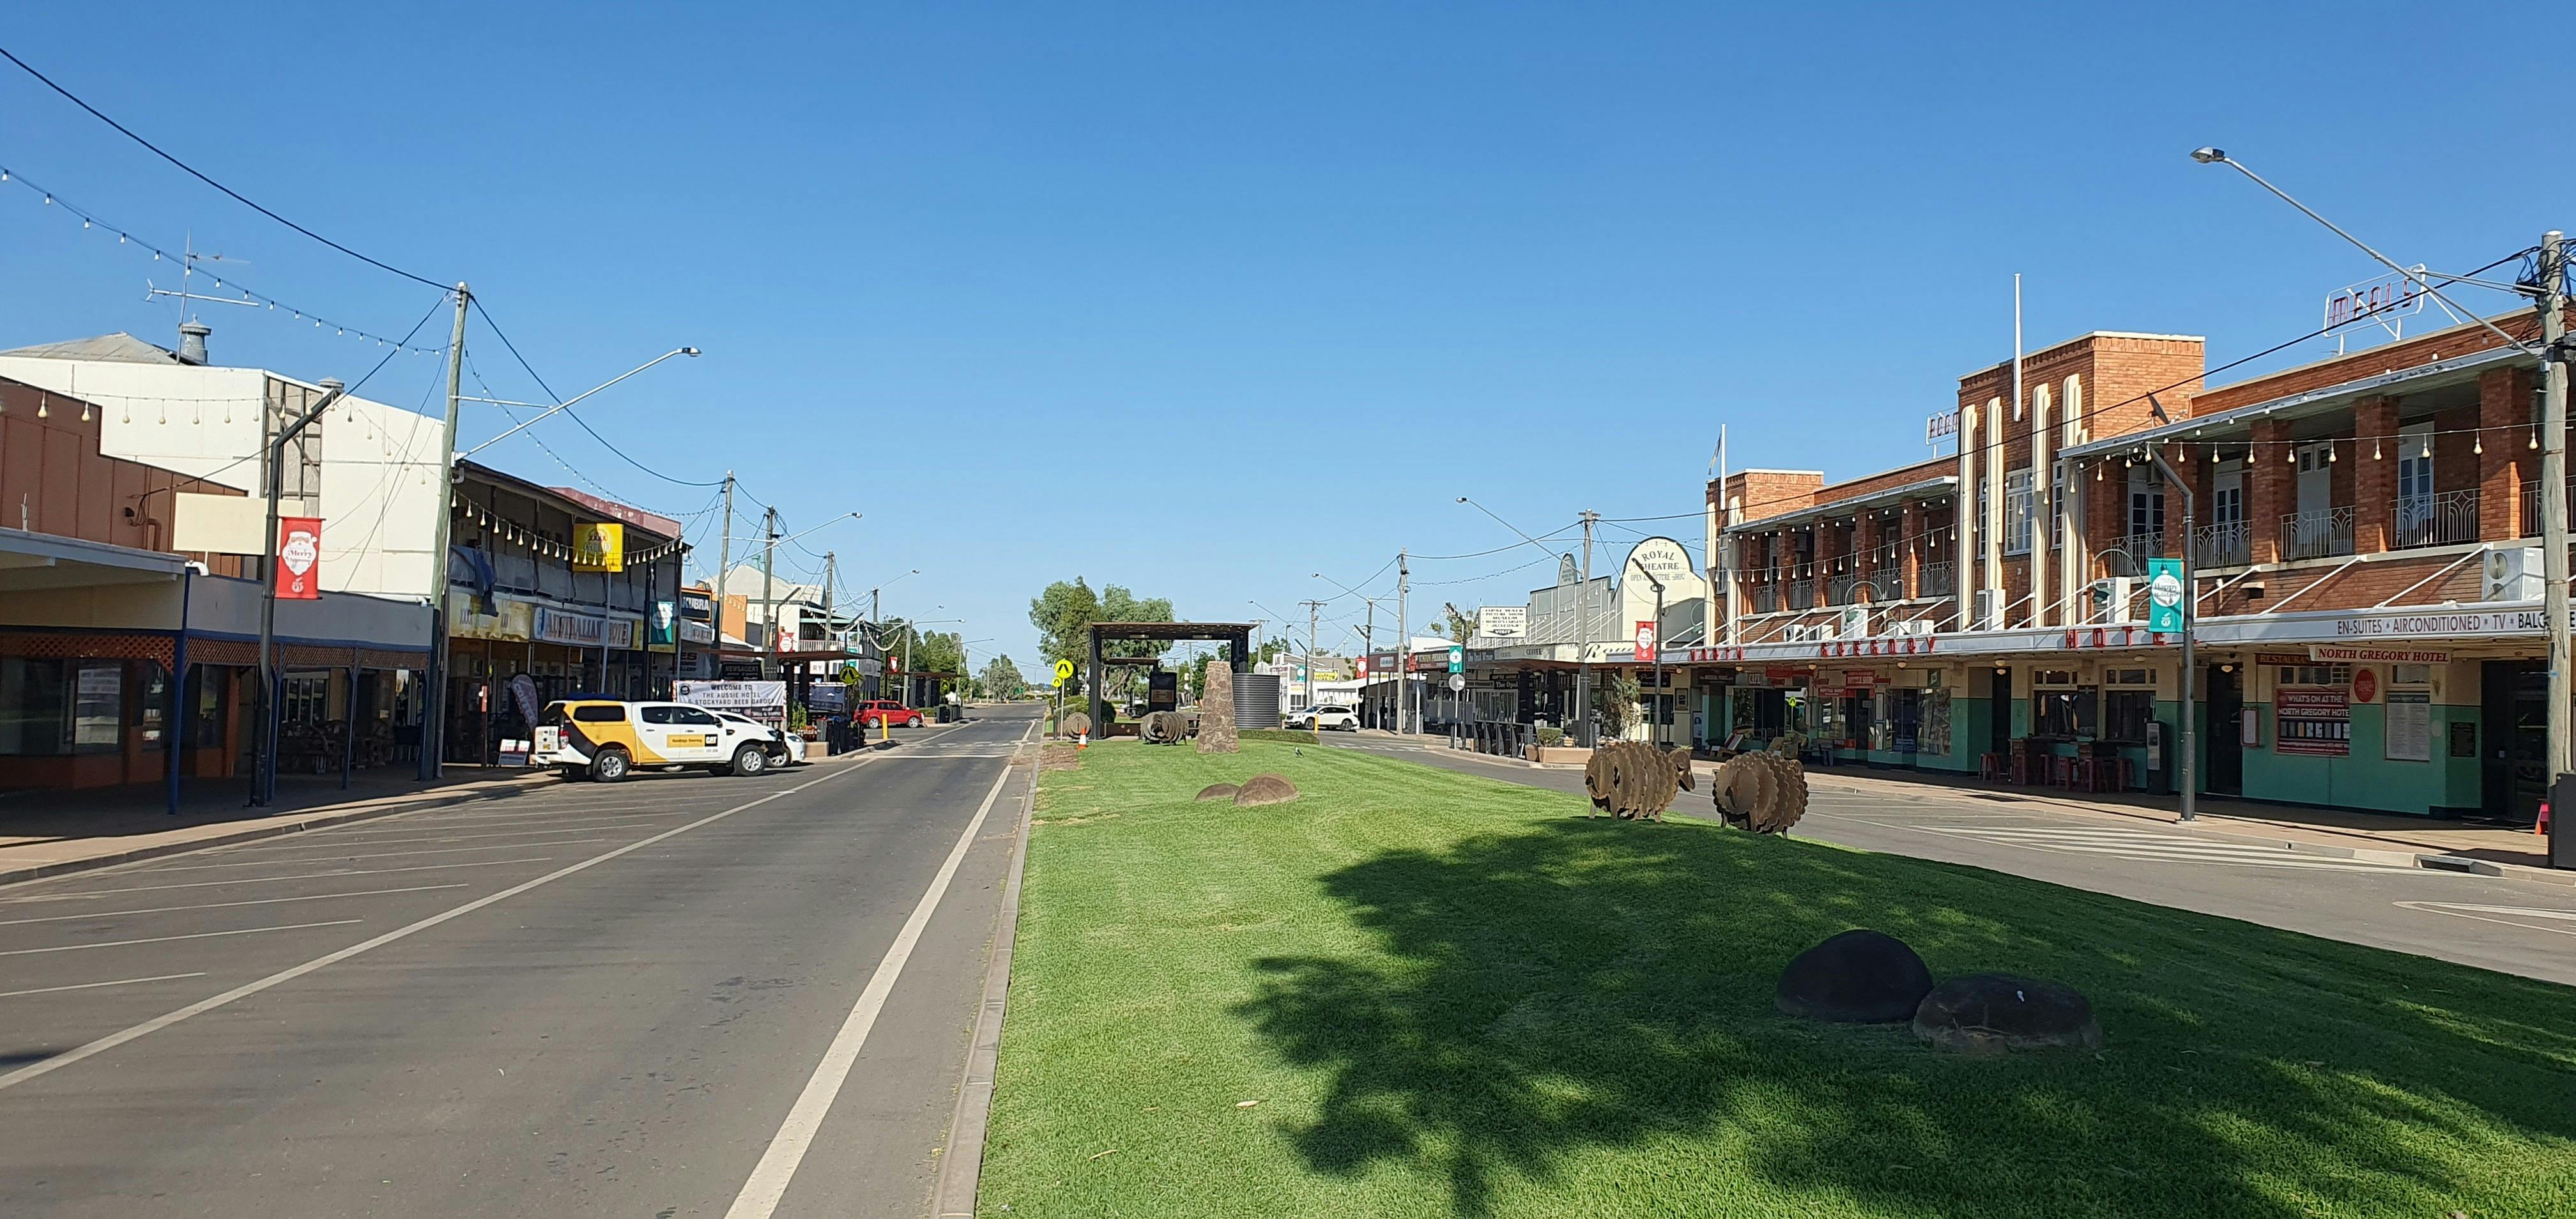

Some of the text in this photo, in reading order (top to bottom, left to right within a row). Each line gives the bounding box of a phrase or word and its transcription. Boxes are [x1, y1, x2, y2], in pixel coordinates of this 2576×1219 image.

[1641, 551, 1675, 562] ROYAL
[2154, 583, 2177, 592] Happy
[682, 597, 709, 611] KUBRA
[2338, 619, 2382, 634] EN-SUITES
[2393, 615, 2481, 633] AIRCONDITIONED
[2493, 615, 2508, 630] TV
[1820, 636, 1936, 657] GREGORY
[2066, 625, 2200, 649] HOTE
[2260, 654, 2311, 664] RESTAURAN
[2319, 648, 2448, 662] NORTH GREGORY HOTEL
[705, 736, 717, 744] CAT
